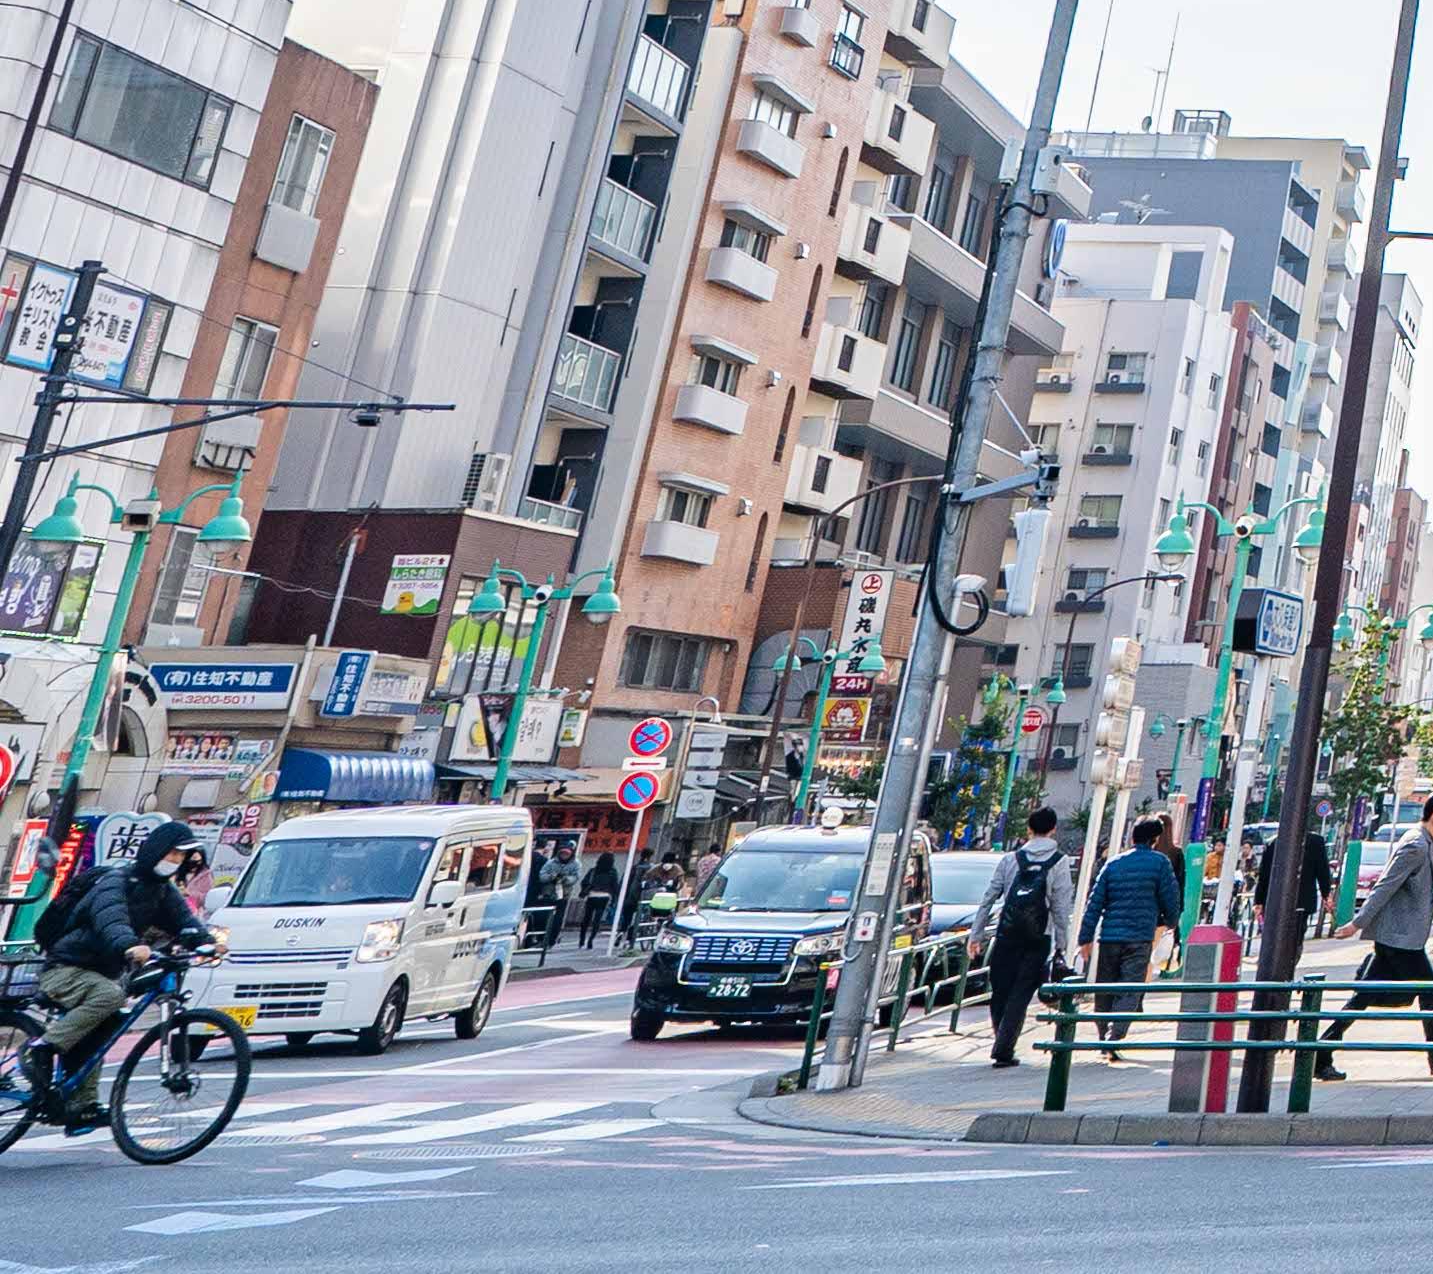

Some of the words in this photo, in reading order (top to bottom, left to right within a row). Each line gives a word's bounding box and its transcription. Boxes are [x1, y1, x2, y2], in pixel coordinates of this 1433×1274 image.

[163, 670, 275, 687] (有)住知不動産
[107, 823, 150, 860] 歯
[273, 917, 327, 929] DUSKIN
